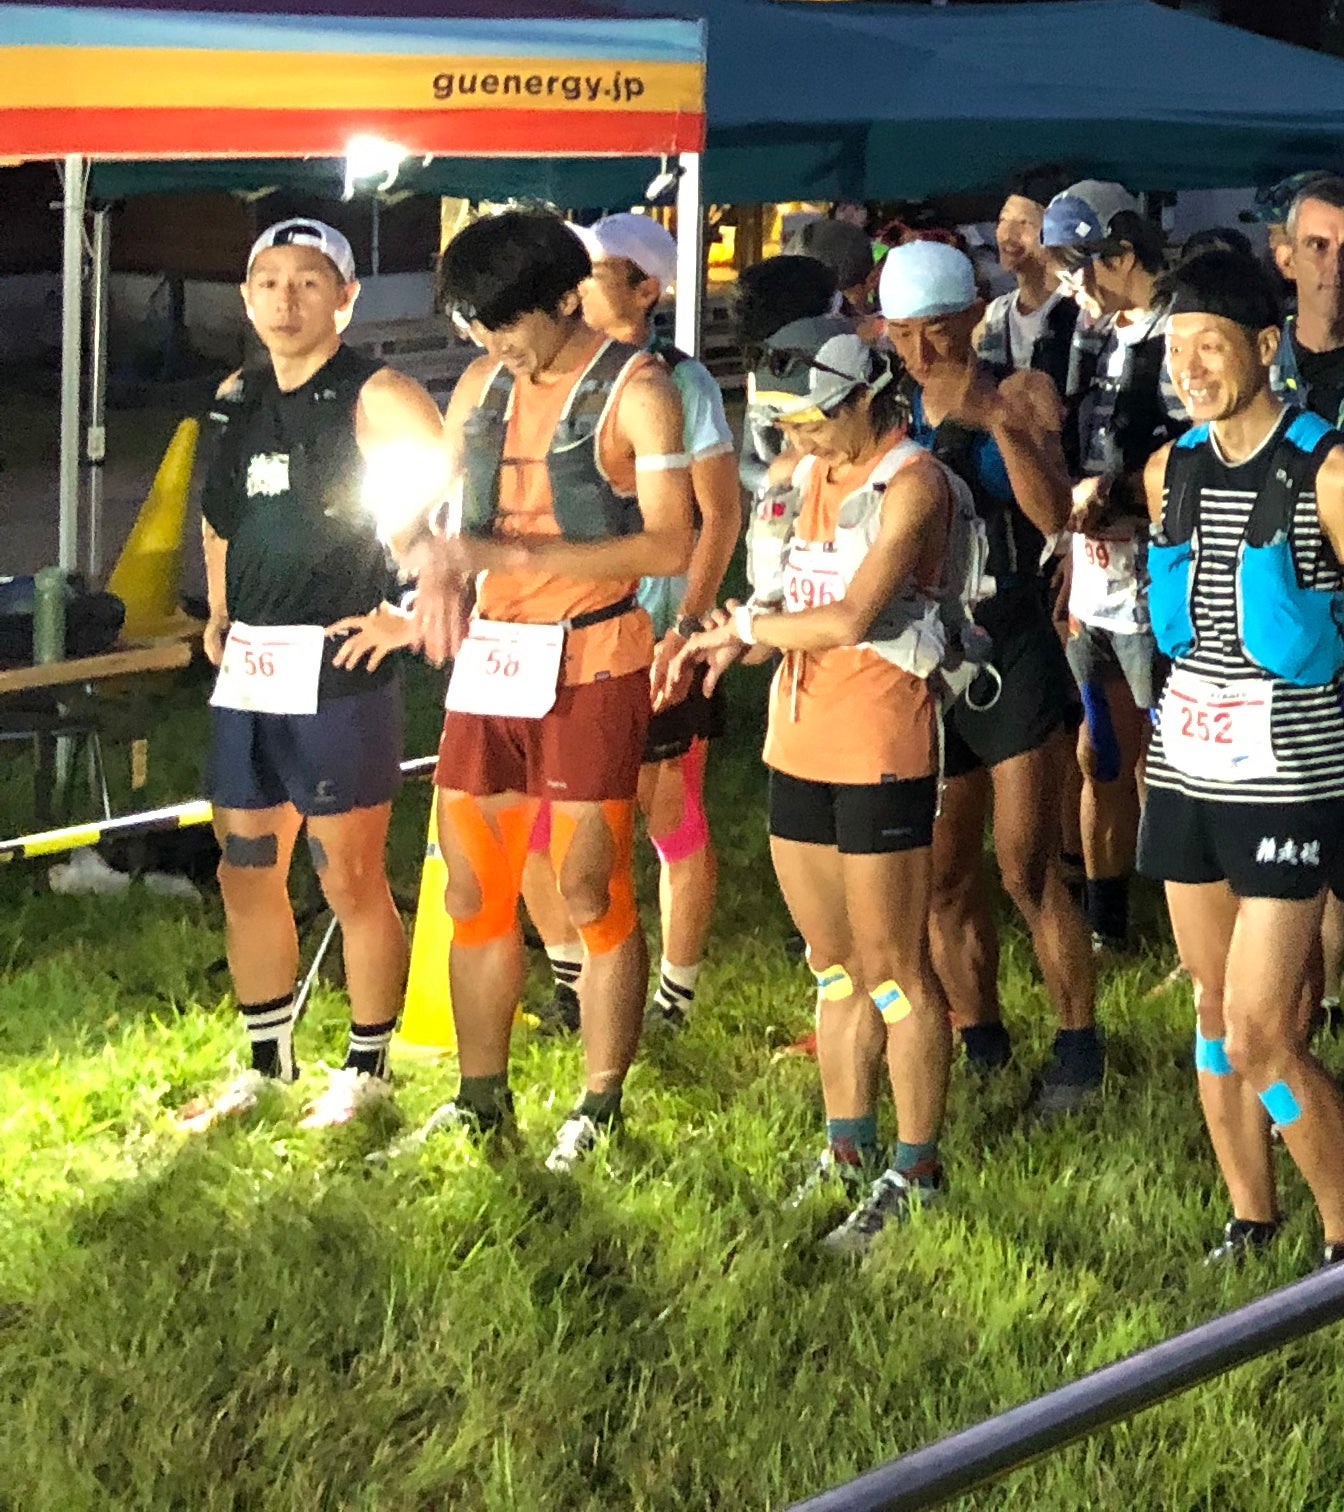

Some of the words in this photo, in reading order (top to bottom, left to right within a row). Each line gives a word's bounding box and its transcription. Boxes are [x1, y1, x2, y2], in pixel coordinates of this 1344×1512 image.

[432, 71, 645, 102] guenergy.jp
[244, 651, 275, 678] 56
[1181, 706, 1233, 744] 252
